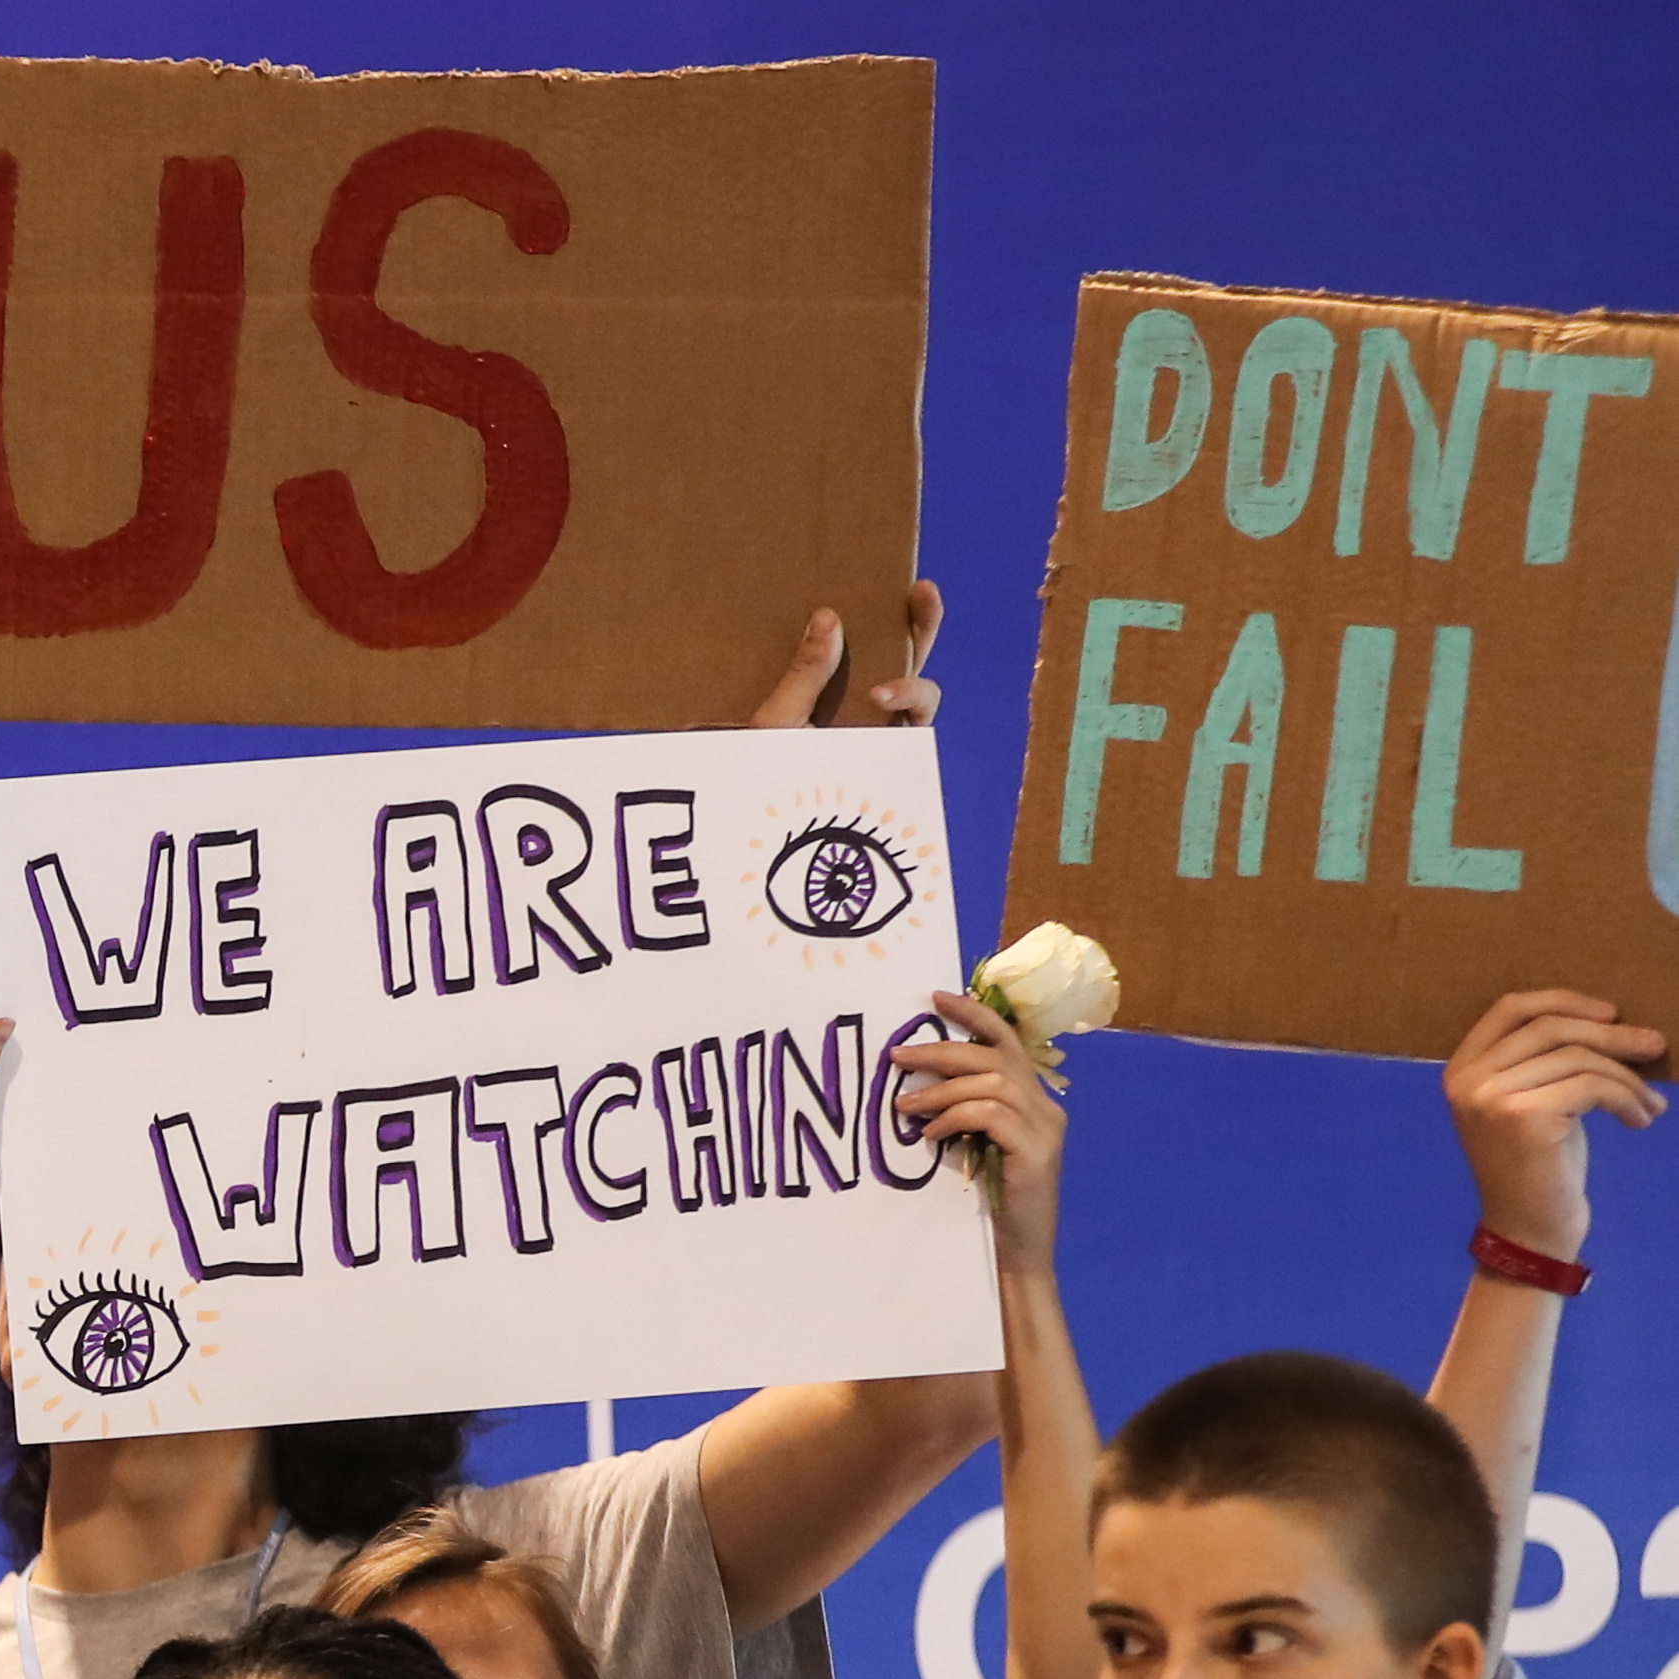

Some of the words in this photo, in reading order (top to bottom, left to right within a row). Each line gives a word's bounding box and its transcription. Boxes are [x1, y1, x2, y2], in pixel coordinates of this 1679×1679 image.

[1103, 308, 1654, 564] DONT
[1059, 599, 1524, 892] FAIL
[25, 829, 272, 1028] WE
[373, 783, 709, 997] ARE
[153, 1011, 954, 1283] WATCHING
